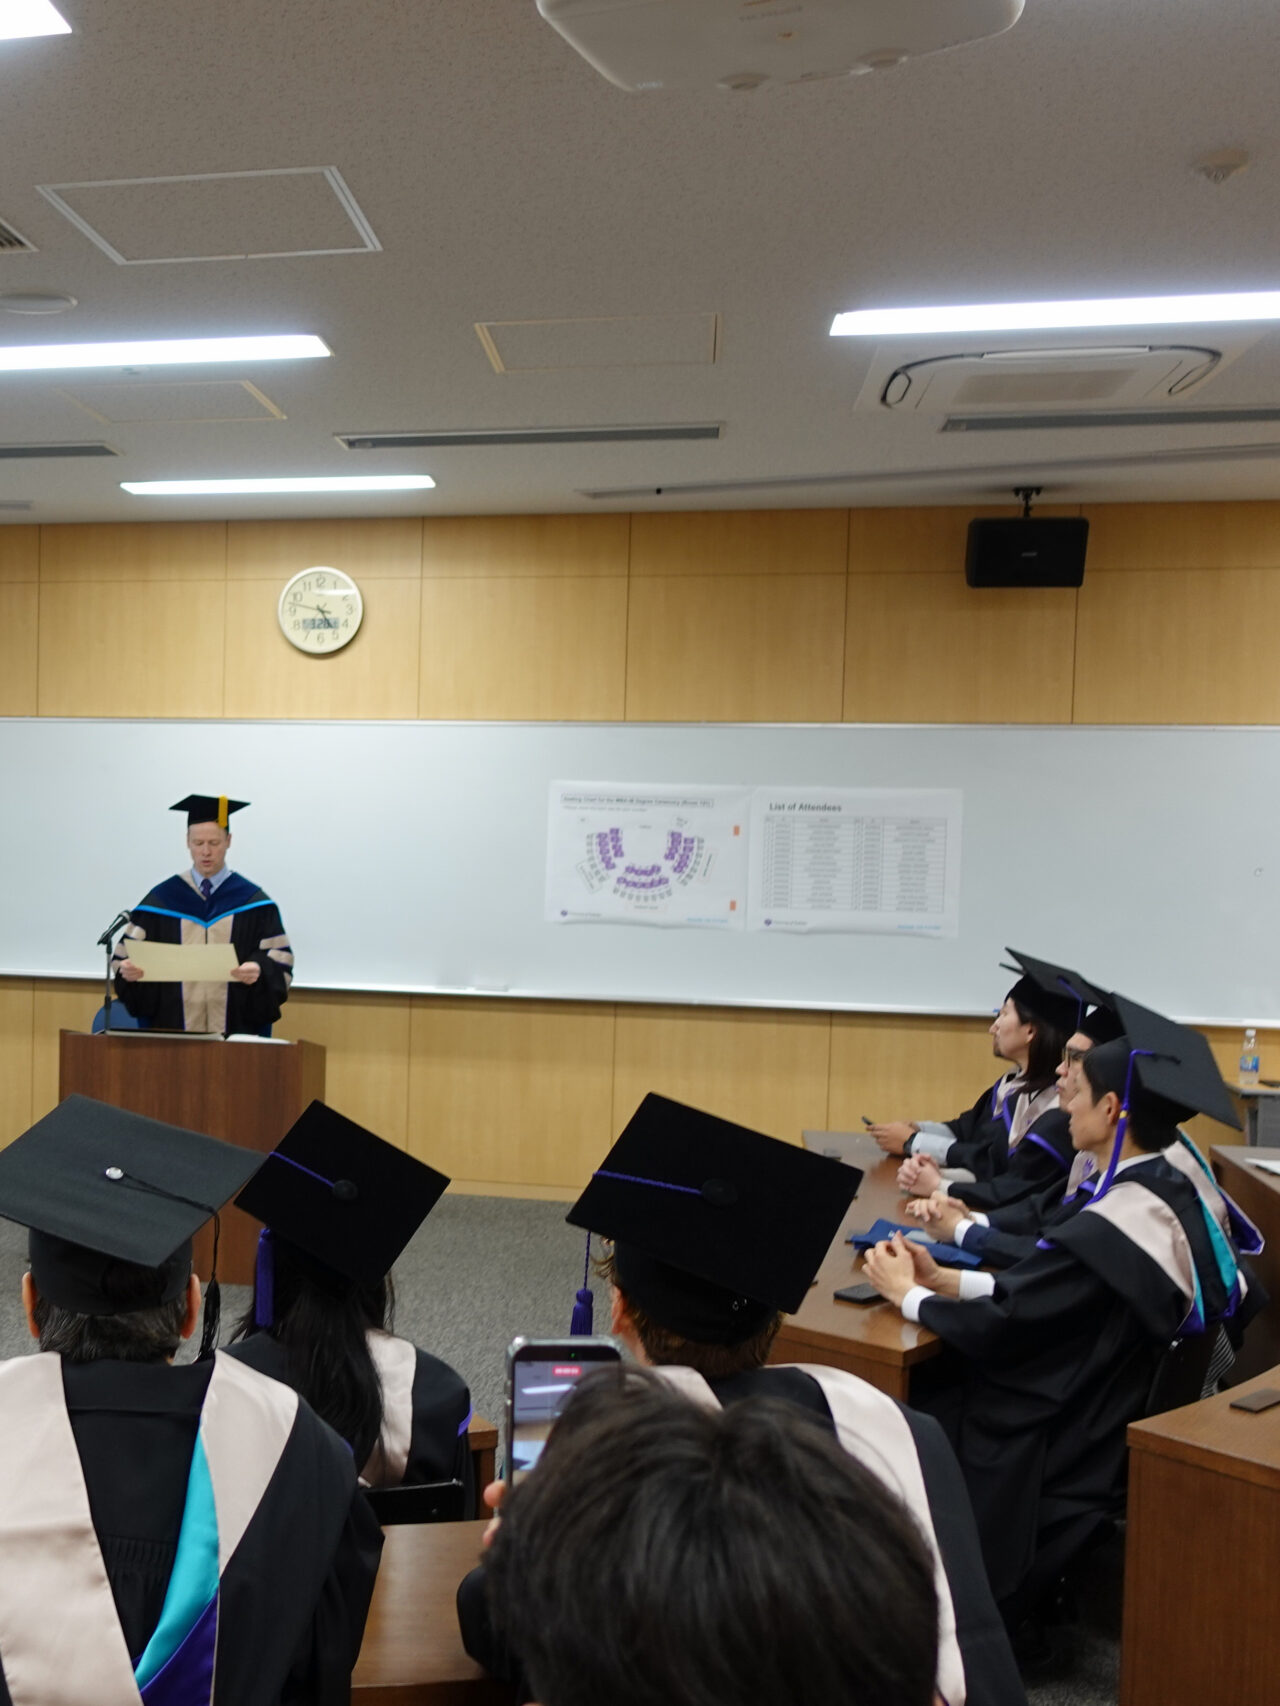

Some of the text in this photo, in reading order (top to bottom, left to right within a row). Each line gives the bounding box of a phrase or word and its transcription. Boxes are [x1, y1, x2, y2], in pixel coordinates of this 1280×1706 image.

[303, 581, 311, 591] 11
[316, 577, 326, 588] 12
[292, 592, 303, 602] 10
[769, 802, 786, 812] List
[798, 803, 842, 814] Attendees
